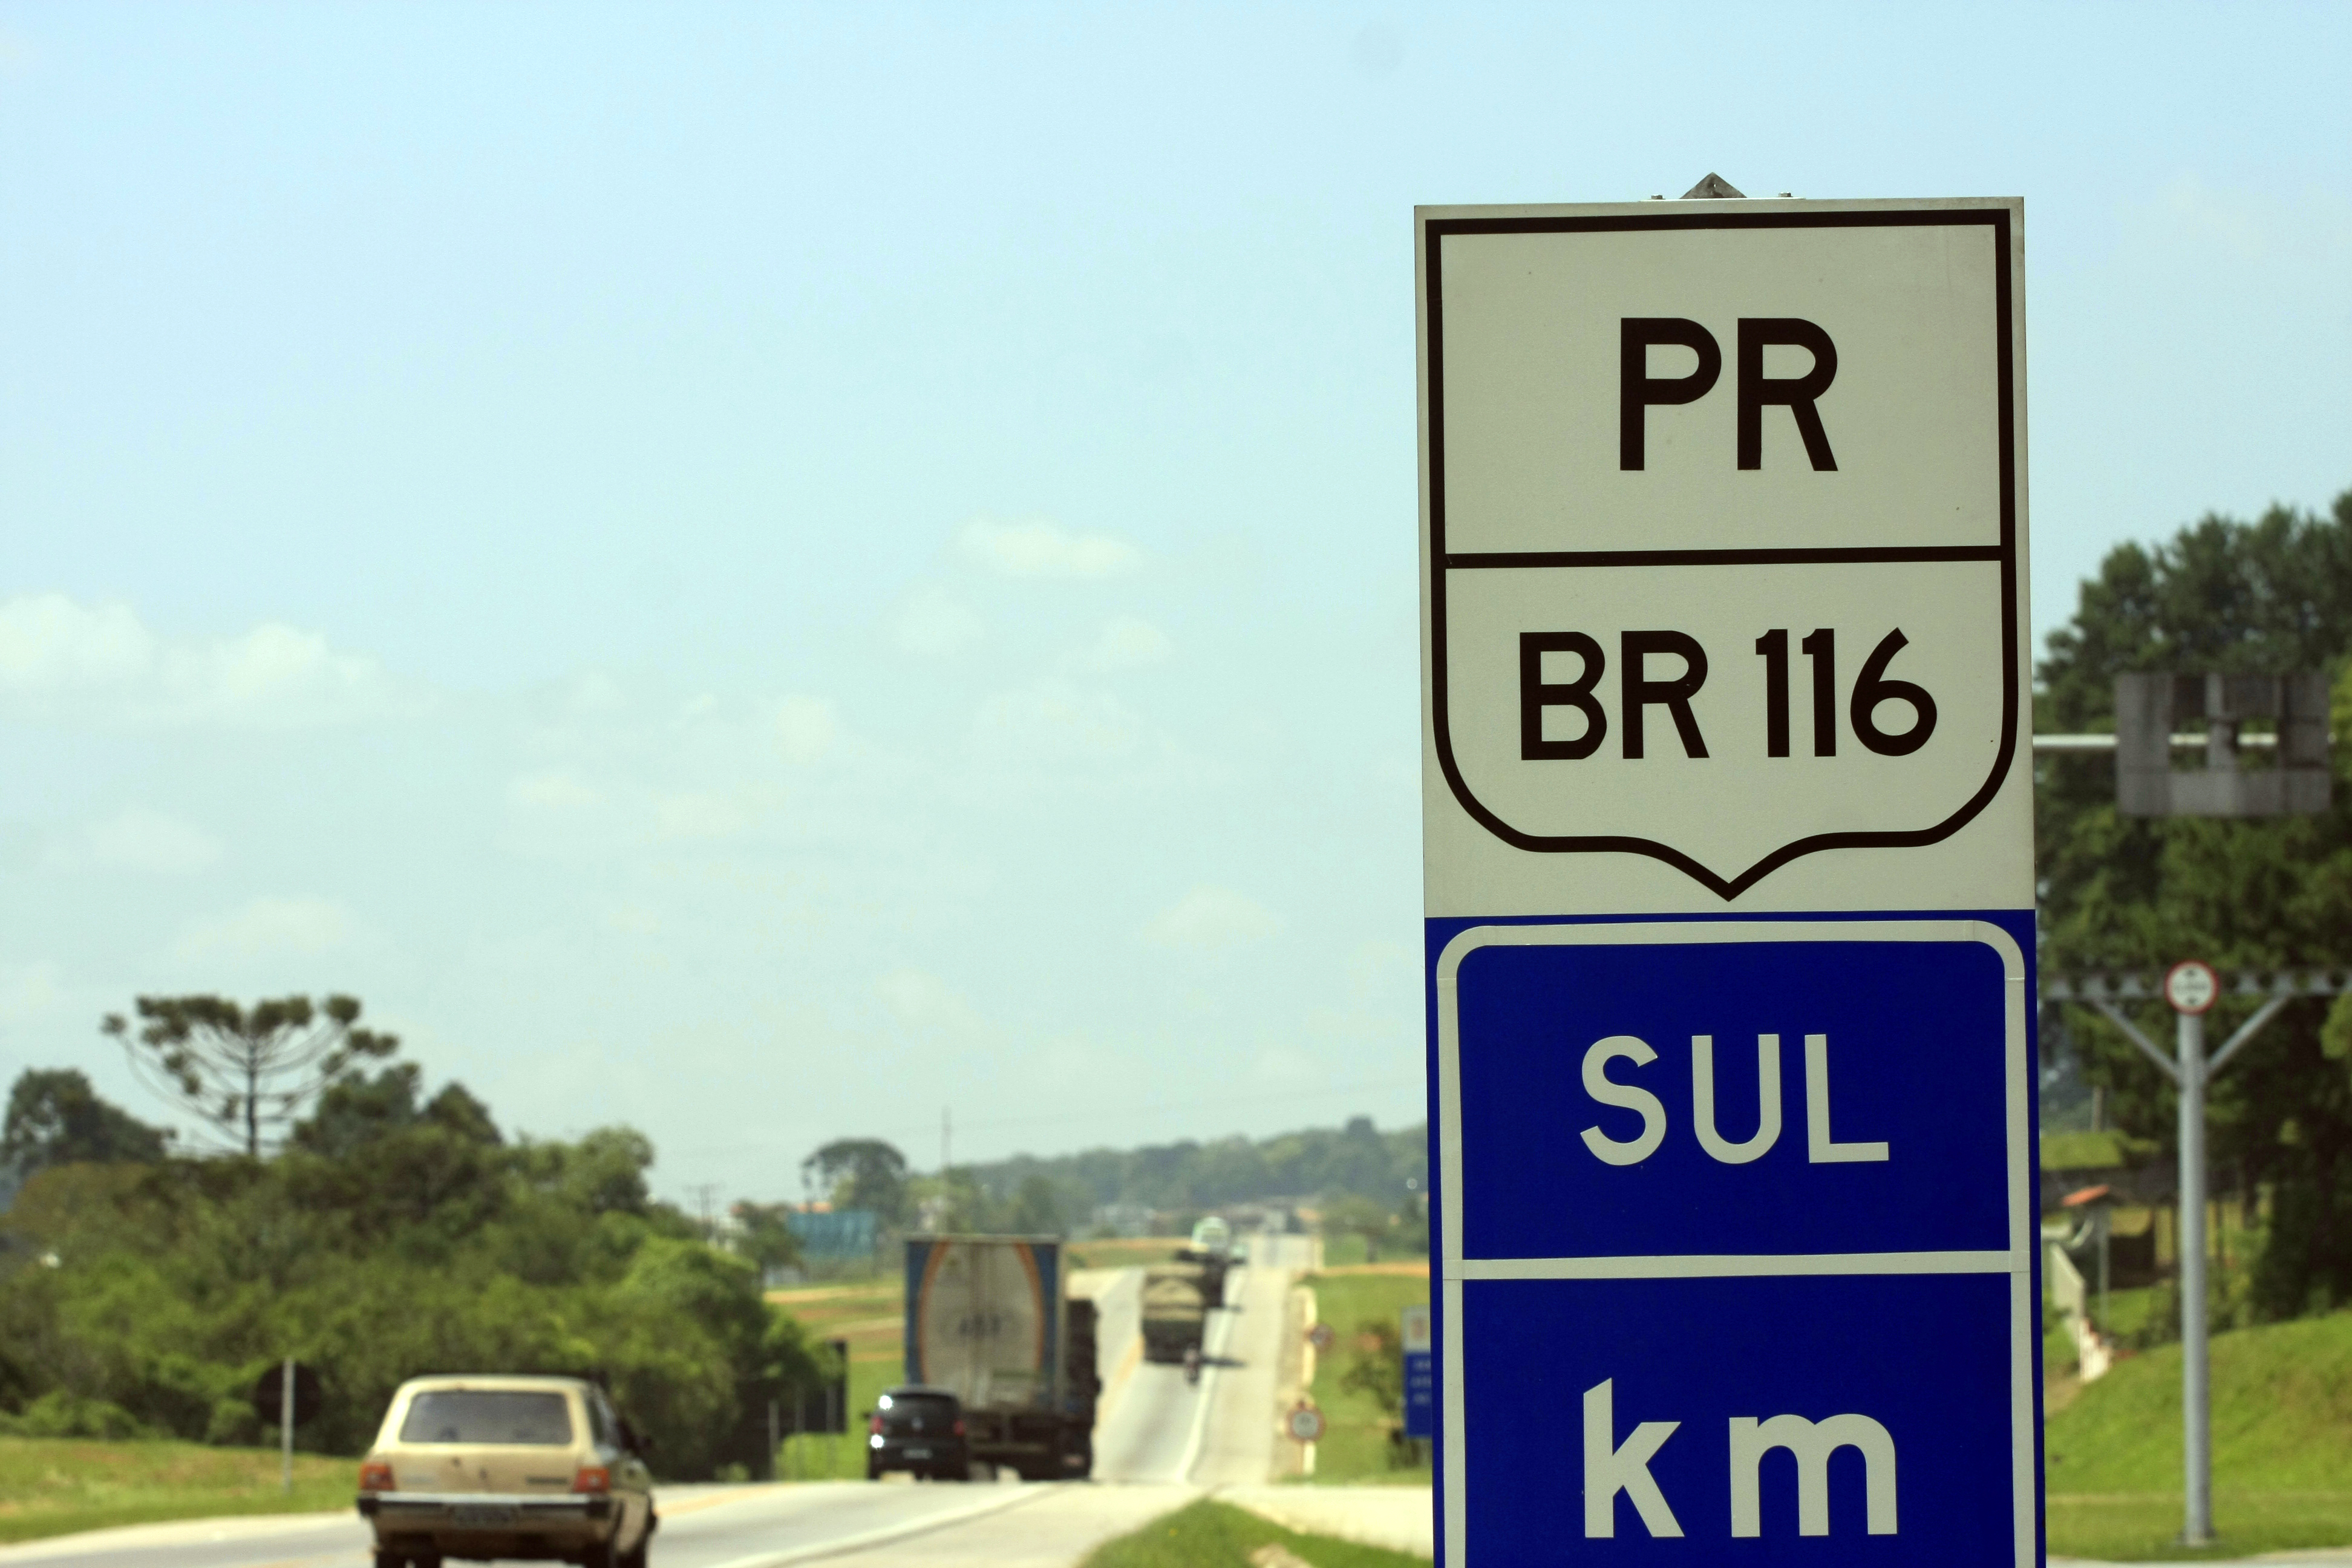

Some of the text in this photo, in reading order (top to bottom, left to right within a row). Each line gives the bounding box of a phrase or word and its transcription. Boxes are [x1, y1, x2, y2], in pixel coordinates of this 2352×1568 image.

[1620, 318, 1838, 471] PR
[1520, 627, 1937, 760] BR 116
[1580, 1034, 1889, 1165] SUL
[1584, 1378, 1897, 1538] km
